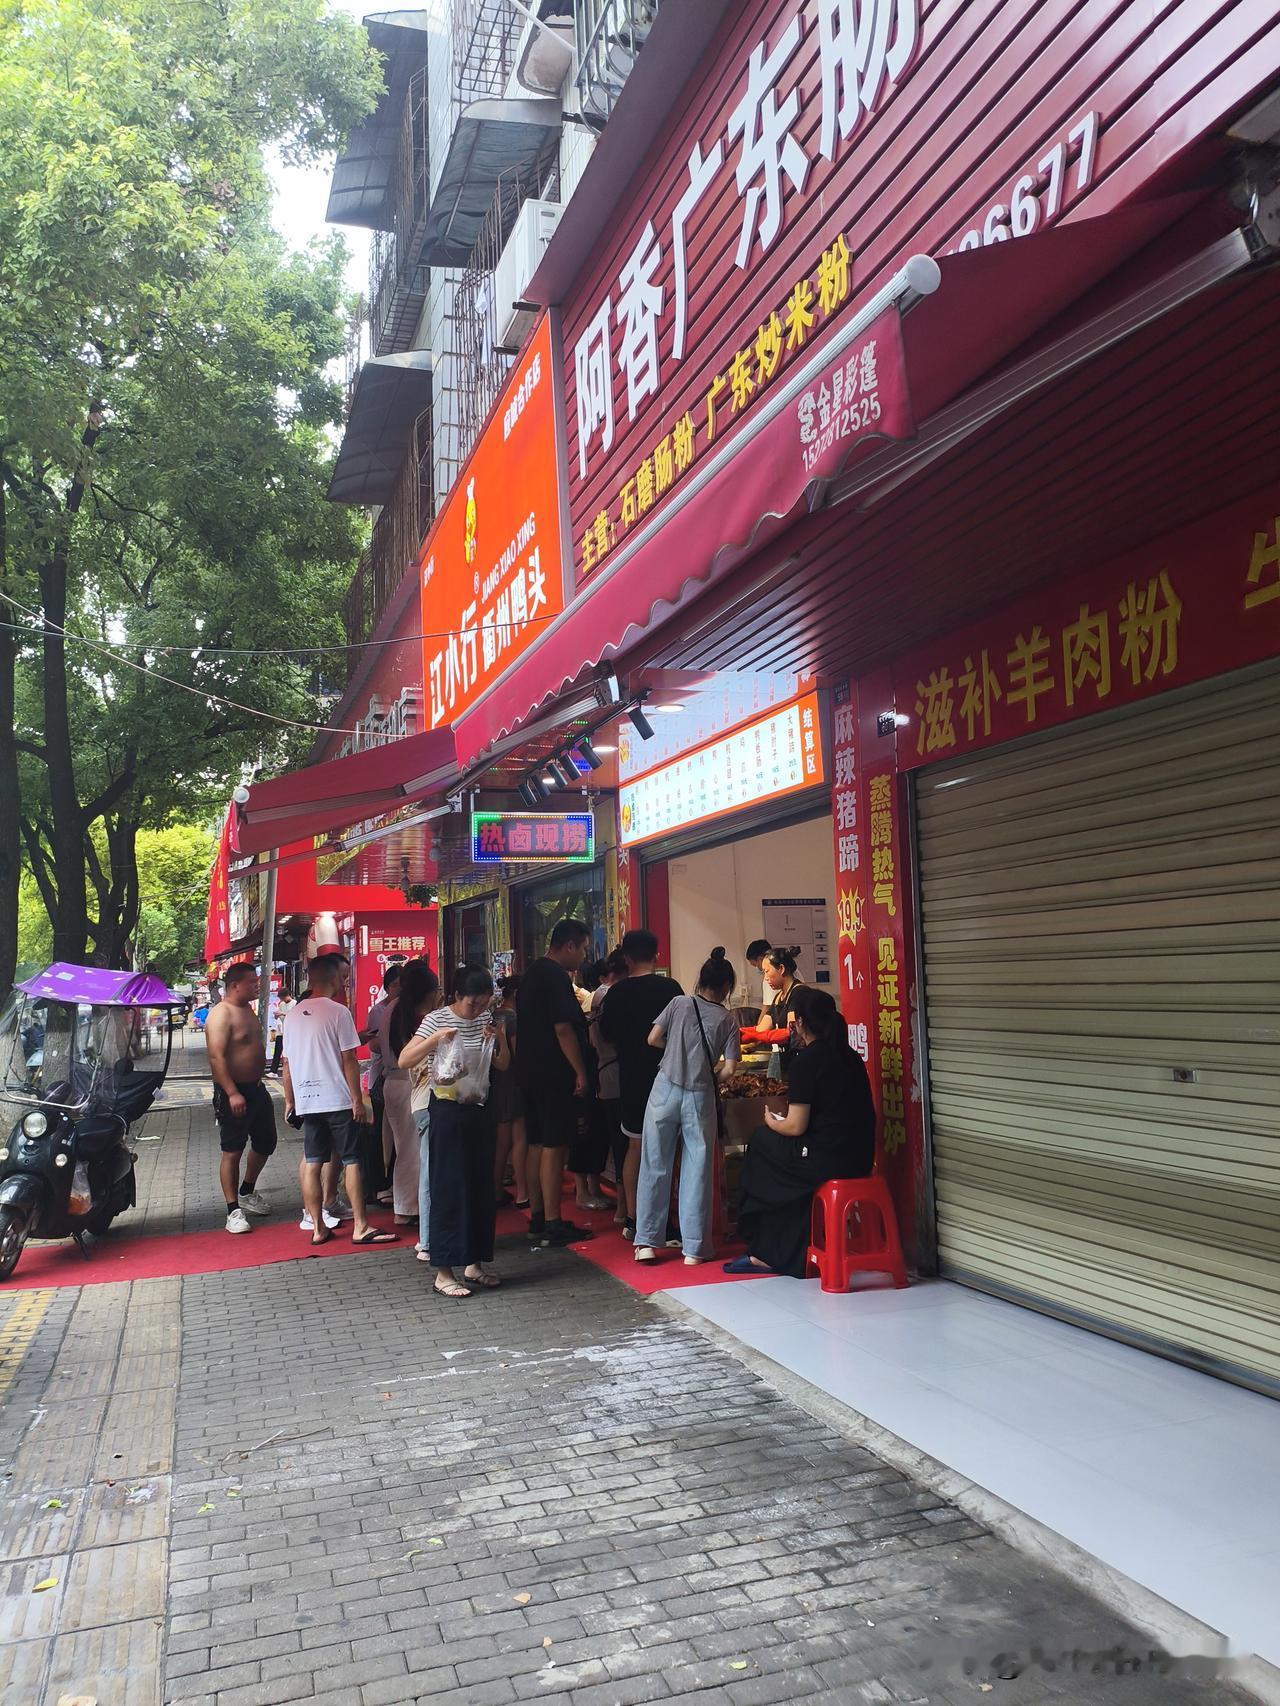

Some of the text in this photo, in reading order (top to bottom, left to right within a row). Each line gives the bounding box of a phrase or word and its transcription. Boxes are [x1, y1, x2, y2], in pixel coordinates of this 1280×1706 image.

[706, 232, 851, 440] 广东炒米粉
[481, 511, 536, 604] JIANG XIAO XING
[429, 600, 477, 730] 江小行
[482, 545, 547, 672] 衢州鸭头
[914, 567, 1182, 756] 滋补羊肉粉
[802, 707, 816, 775] 结算区
[833, 703, 860, 874] 麻辣猪蹄
[481, 822, 586, 853] 热卤现捞
[369, 936, 425, 952] 雪王推荐
[838, 896, 861, 932] 19.9
[869, 774, 907, 1156] 蒸腾热气 见证新鲜出炉
